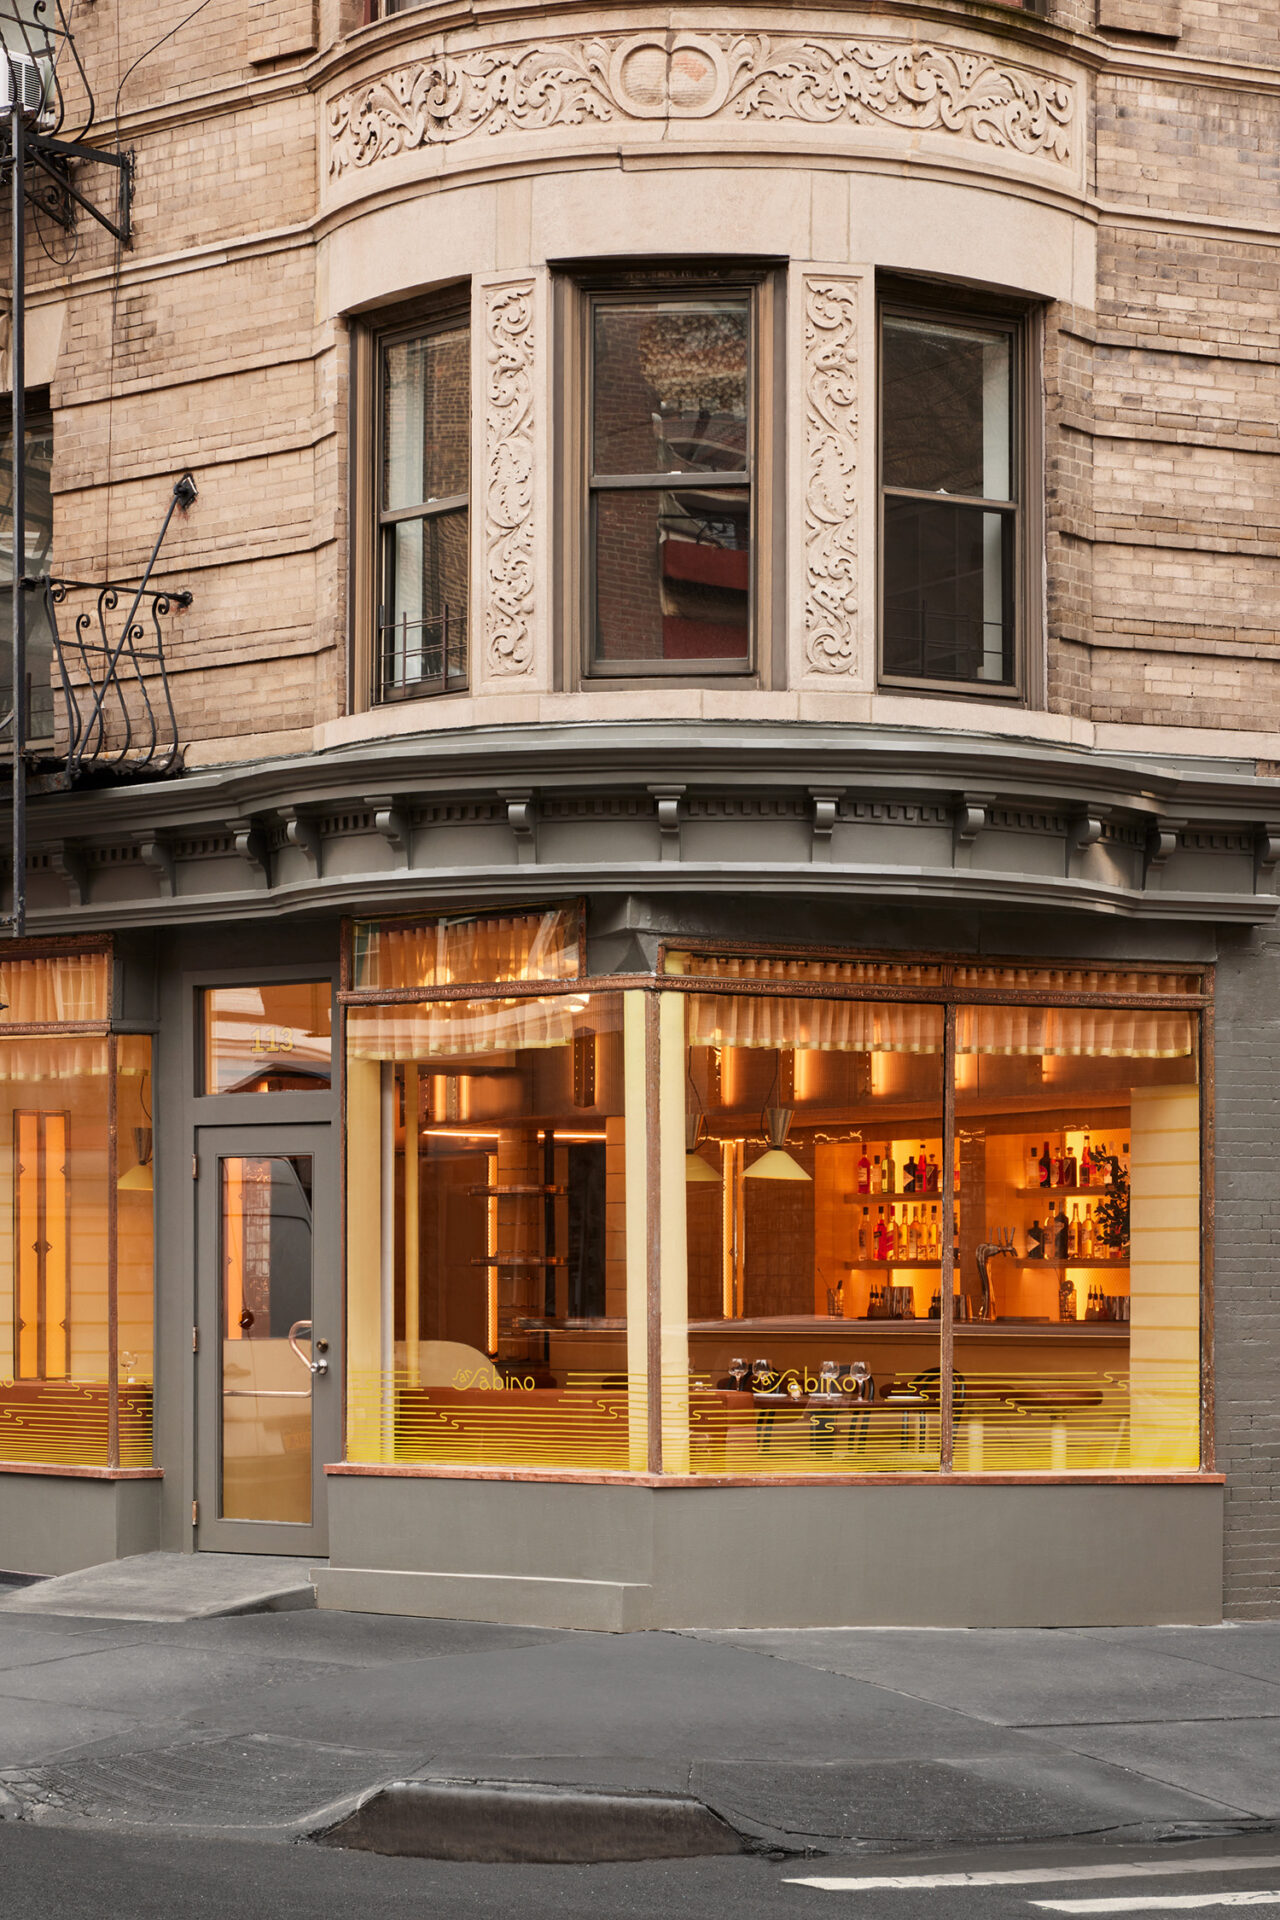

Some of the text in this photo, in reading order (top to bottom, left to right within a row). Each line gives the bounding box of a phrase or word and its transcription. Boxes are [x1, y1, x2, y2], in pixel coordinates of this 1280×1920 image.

[251, 1026, 294, 1053] 113
[452, 1365, 535, 1391] Sabino
[752, 1366, 856, 1393] Sabino
